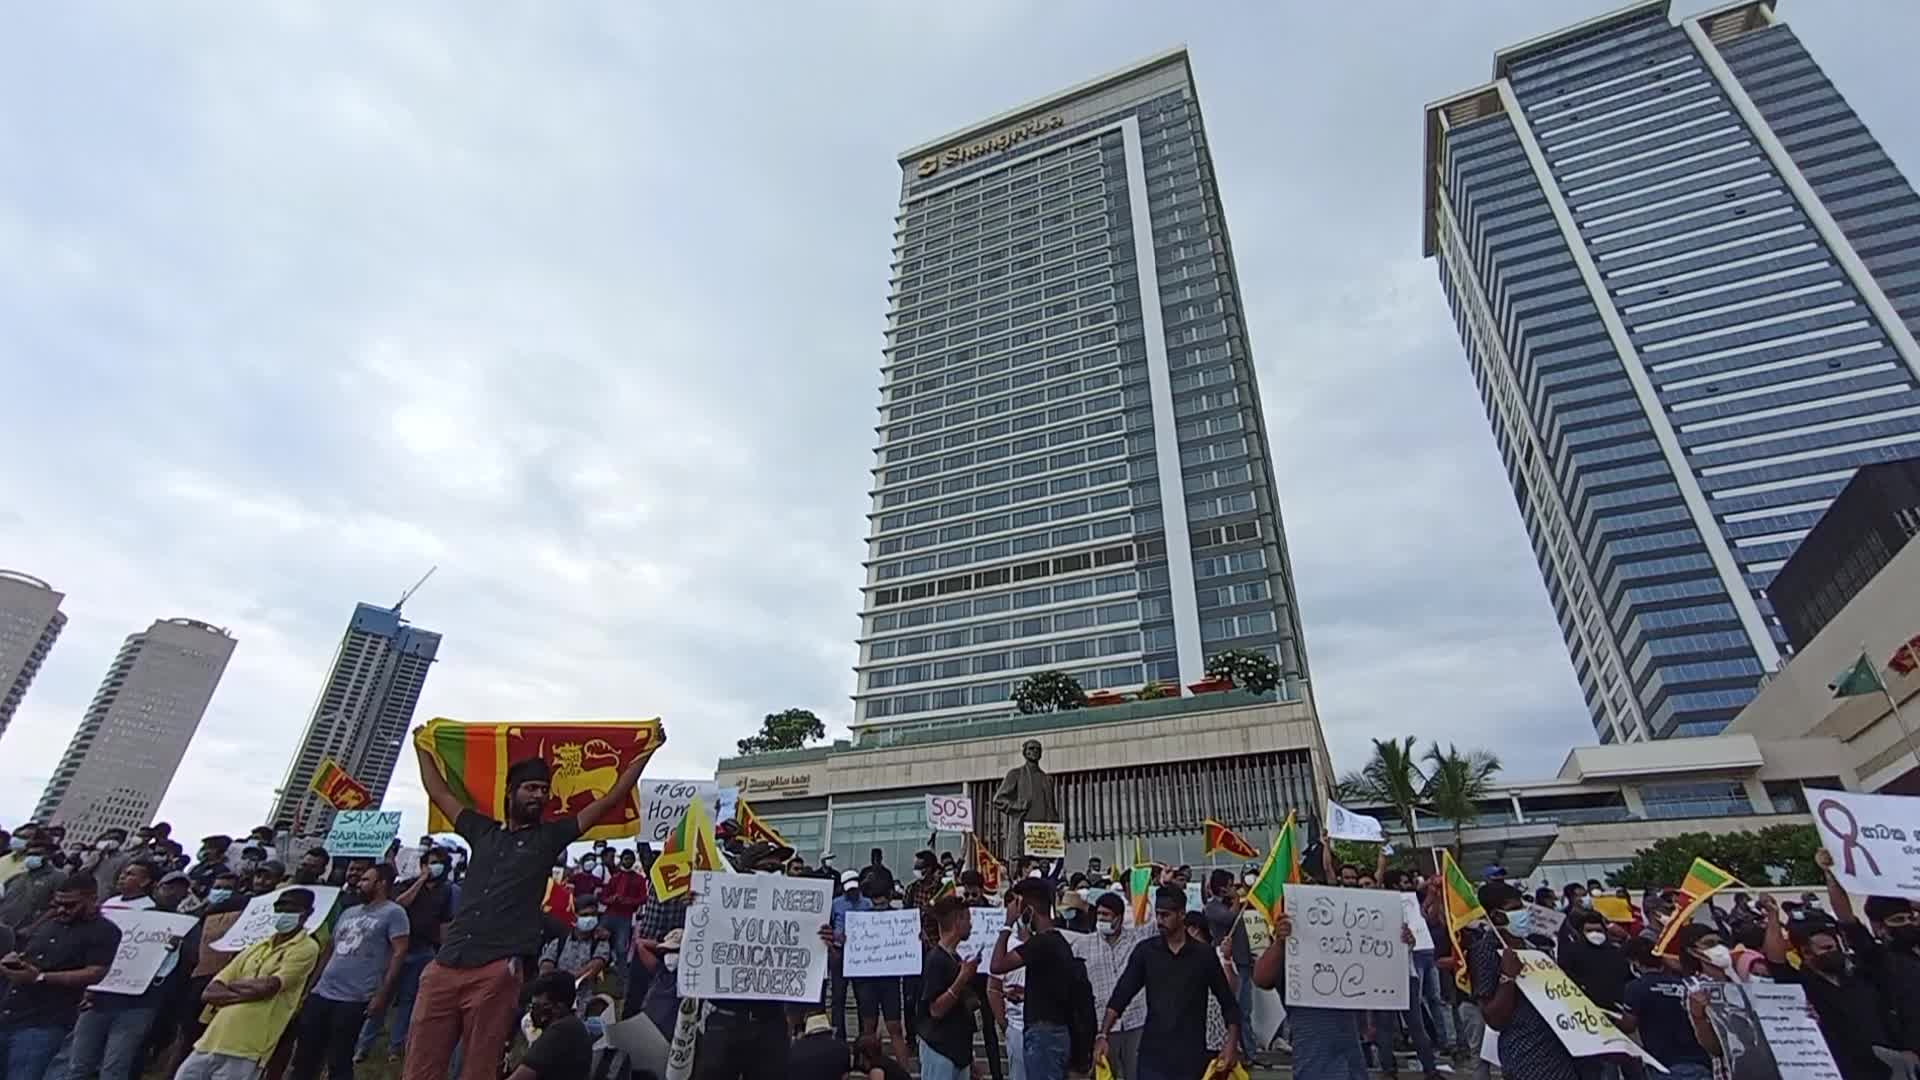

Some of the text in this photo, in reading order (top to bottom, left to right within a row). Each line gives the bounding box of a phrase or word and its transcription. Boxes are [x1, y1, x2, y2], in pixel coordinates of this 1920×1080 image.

[339, 810, 400, 825] SAY NO
[648, 800, 690, 821] Hom
[932, 797, 968, 819] SOS
[721, 886, 824, 914] WE NEED
[731, 917, 800, 946] YOUNG
[711, 942, 811, 968] EDUCATED
[715, 967, 807, 997] LEADERS
